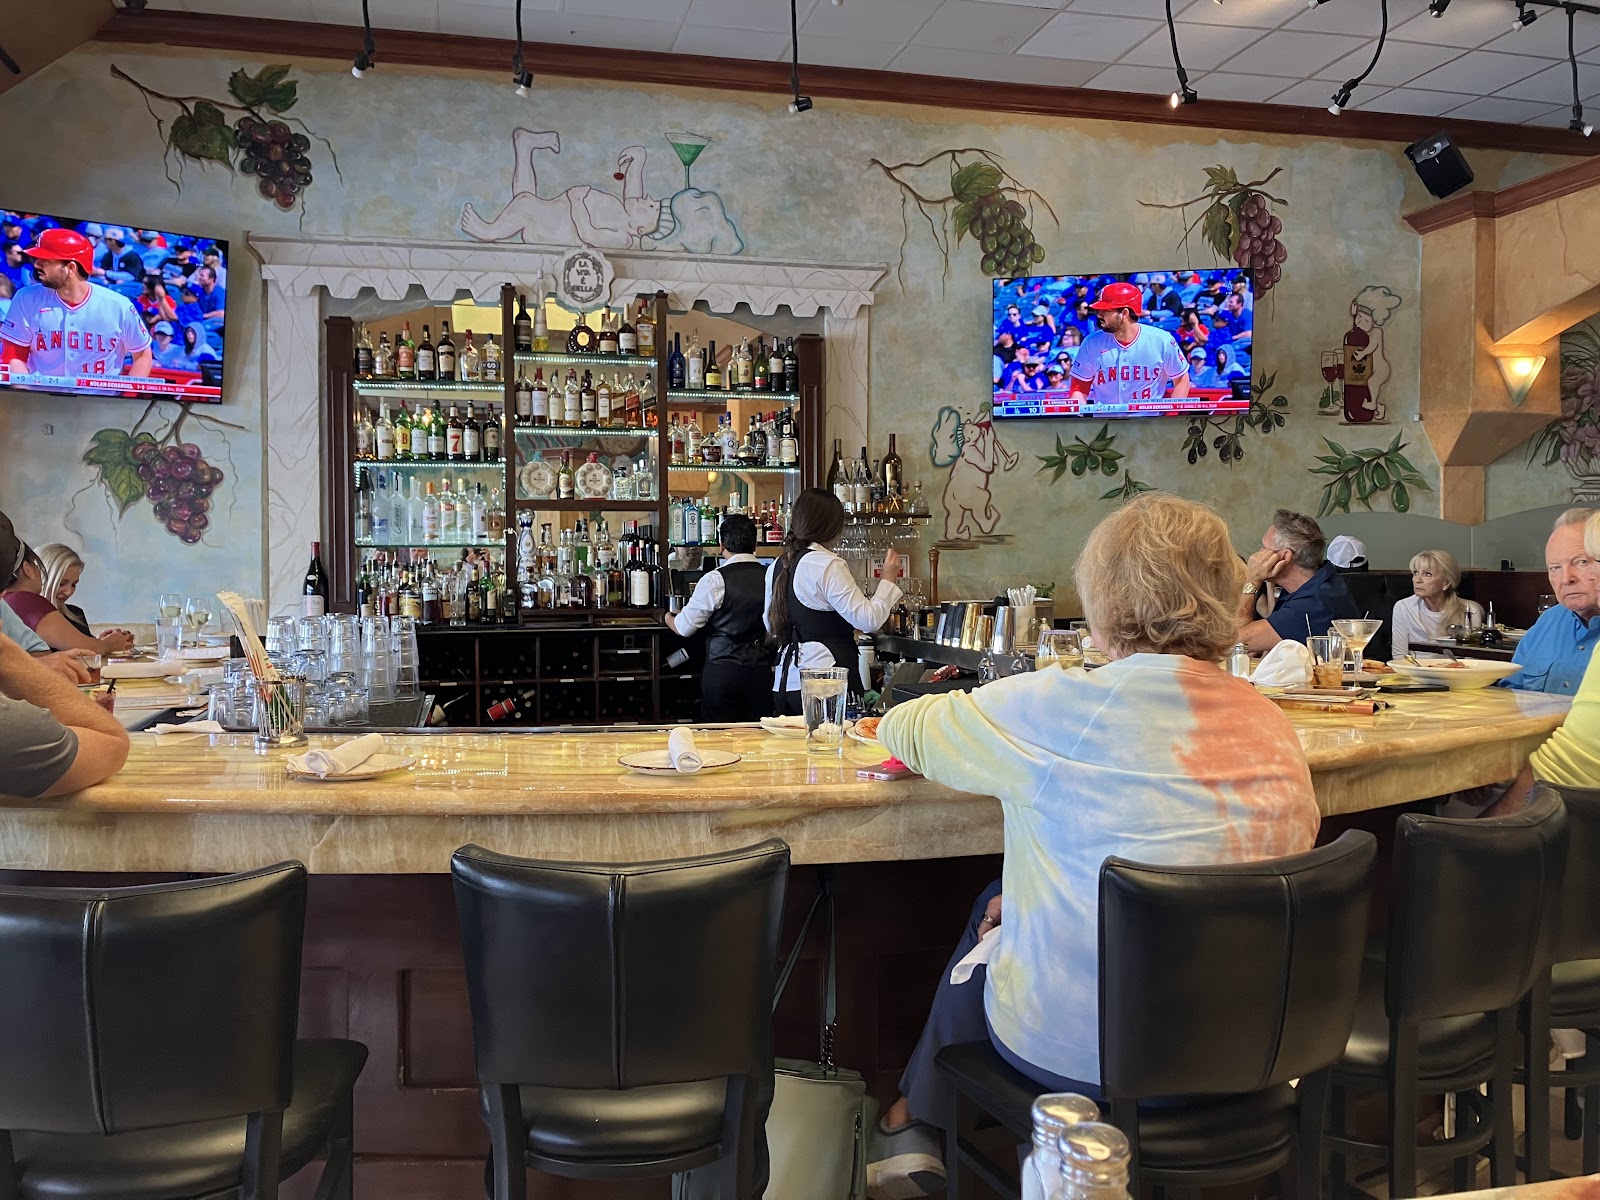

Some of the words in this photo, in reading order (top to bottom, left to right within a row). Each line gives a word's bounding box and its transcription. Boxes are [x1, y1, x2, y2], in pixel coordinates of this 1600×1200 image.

[35, 330, 118, 352] ANGELS
[1097, 365, 1160, 386] ANGELS
[449, 434, 461, 453] 7
